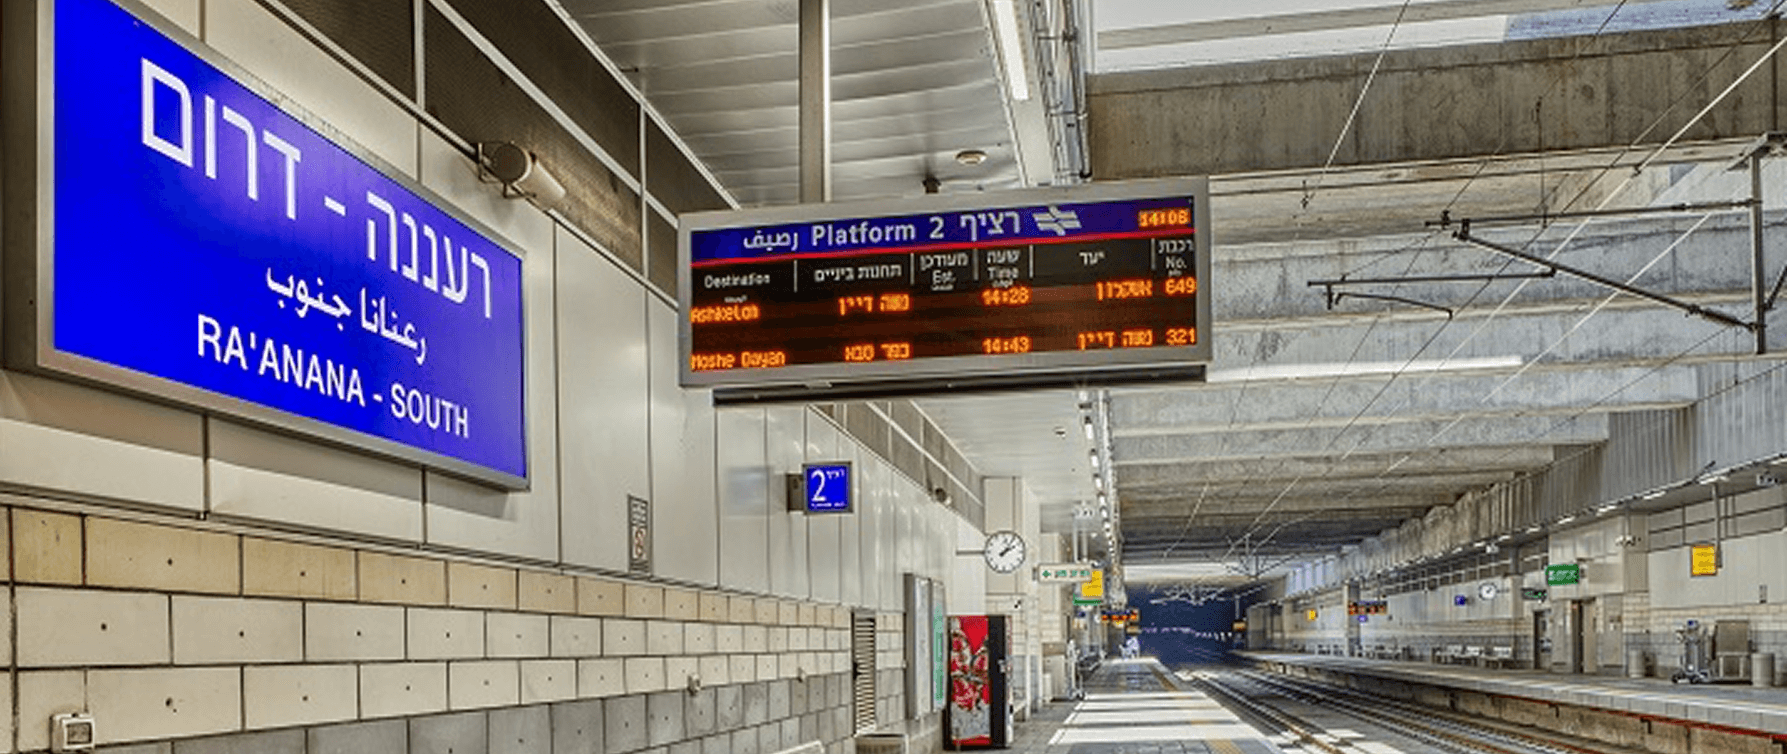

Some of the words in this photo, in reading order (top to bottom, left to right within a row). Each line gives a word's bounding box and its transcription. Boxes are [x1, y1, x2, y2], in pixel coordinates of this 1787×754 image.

[141, 57, 300, 220] דרום
[743, 229, 799, 251] رصيف
[811, 222, 916, 247] Platform
[929, 216, 946, 239] 2
[960, 211, 1021, 242] רציף
[367, 190, 492, 318] רעננה
[987, 250, 1020, 263] שעה
[1079, 251, 1105, 265] יעד
[704, 273, 770, 288] Destination
[858, 264, 902, 279] תחנות
[1165, 277, 1196, 295] 649
[266, 268, 352, 332] جنوب
[982, 287, 1030, 305] 14:28
[839, 296, 874, 315] דיין
[360, 287, 426, 365] رعنانا
[982, 336, 1030, 353] 14:43
[1078, 332, 1115, 351] דיין
[1165, 328, 1196, 344] 321
[741, 351, 786, 368] Dayan
[844, 345, 875, 362] סבא
[198, 313, 366, 407] RA'ANANA
[391, 383, 469, 439] SOUTH
[811, 470, 827, 501] 2
